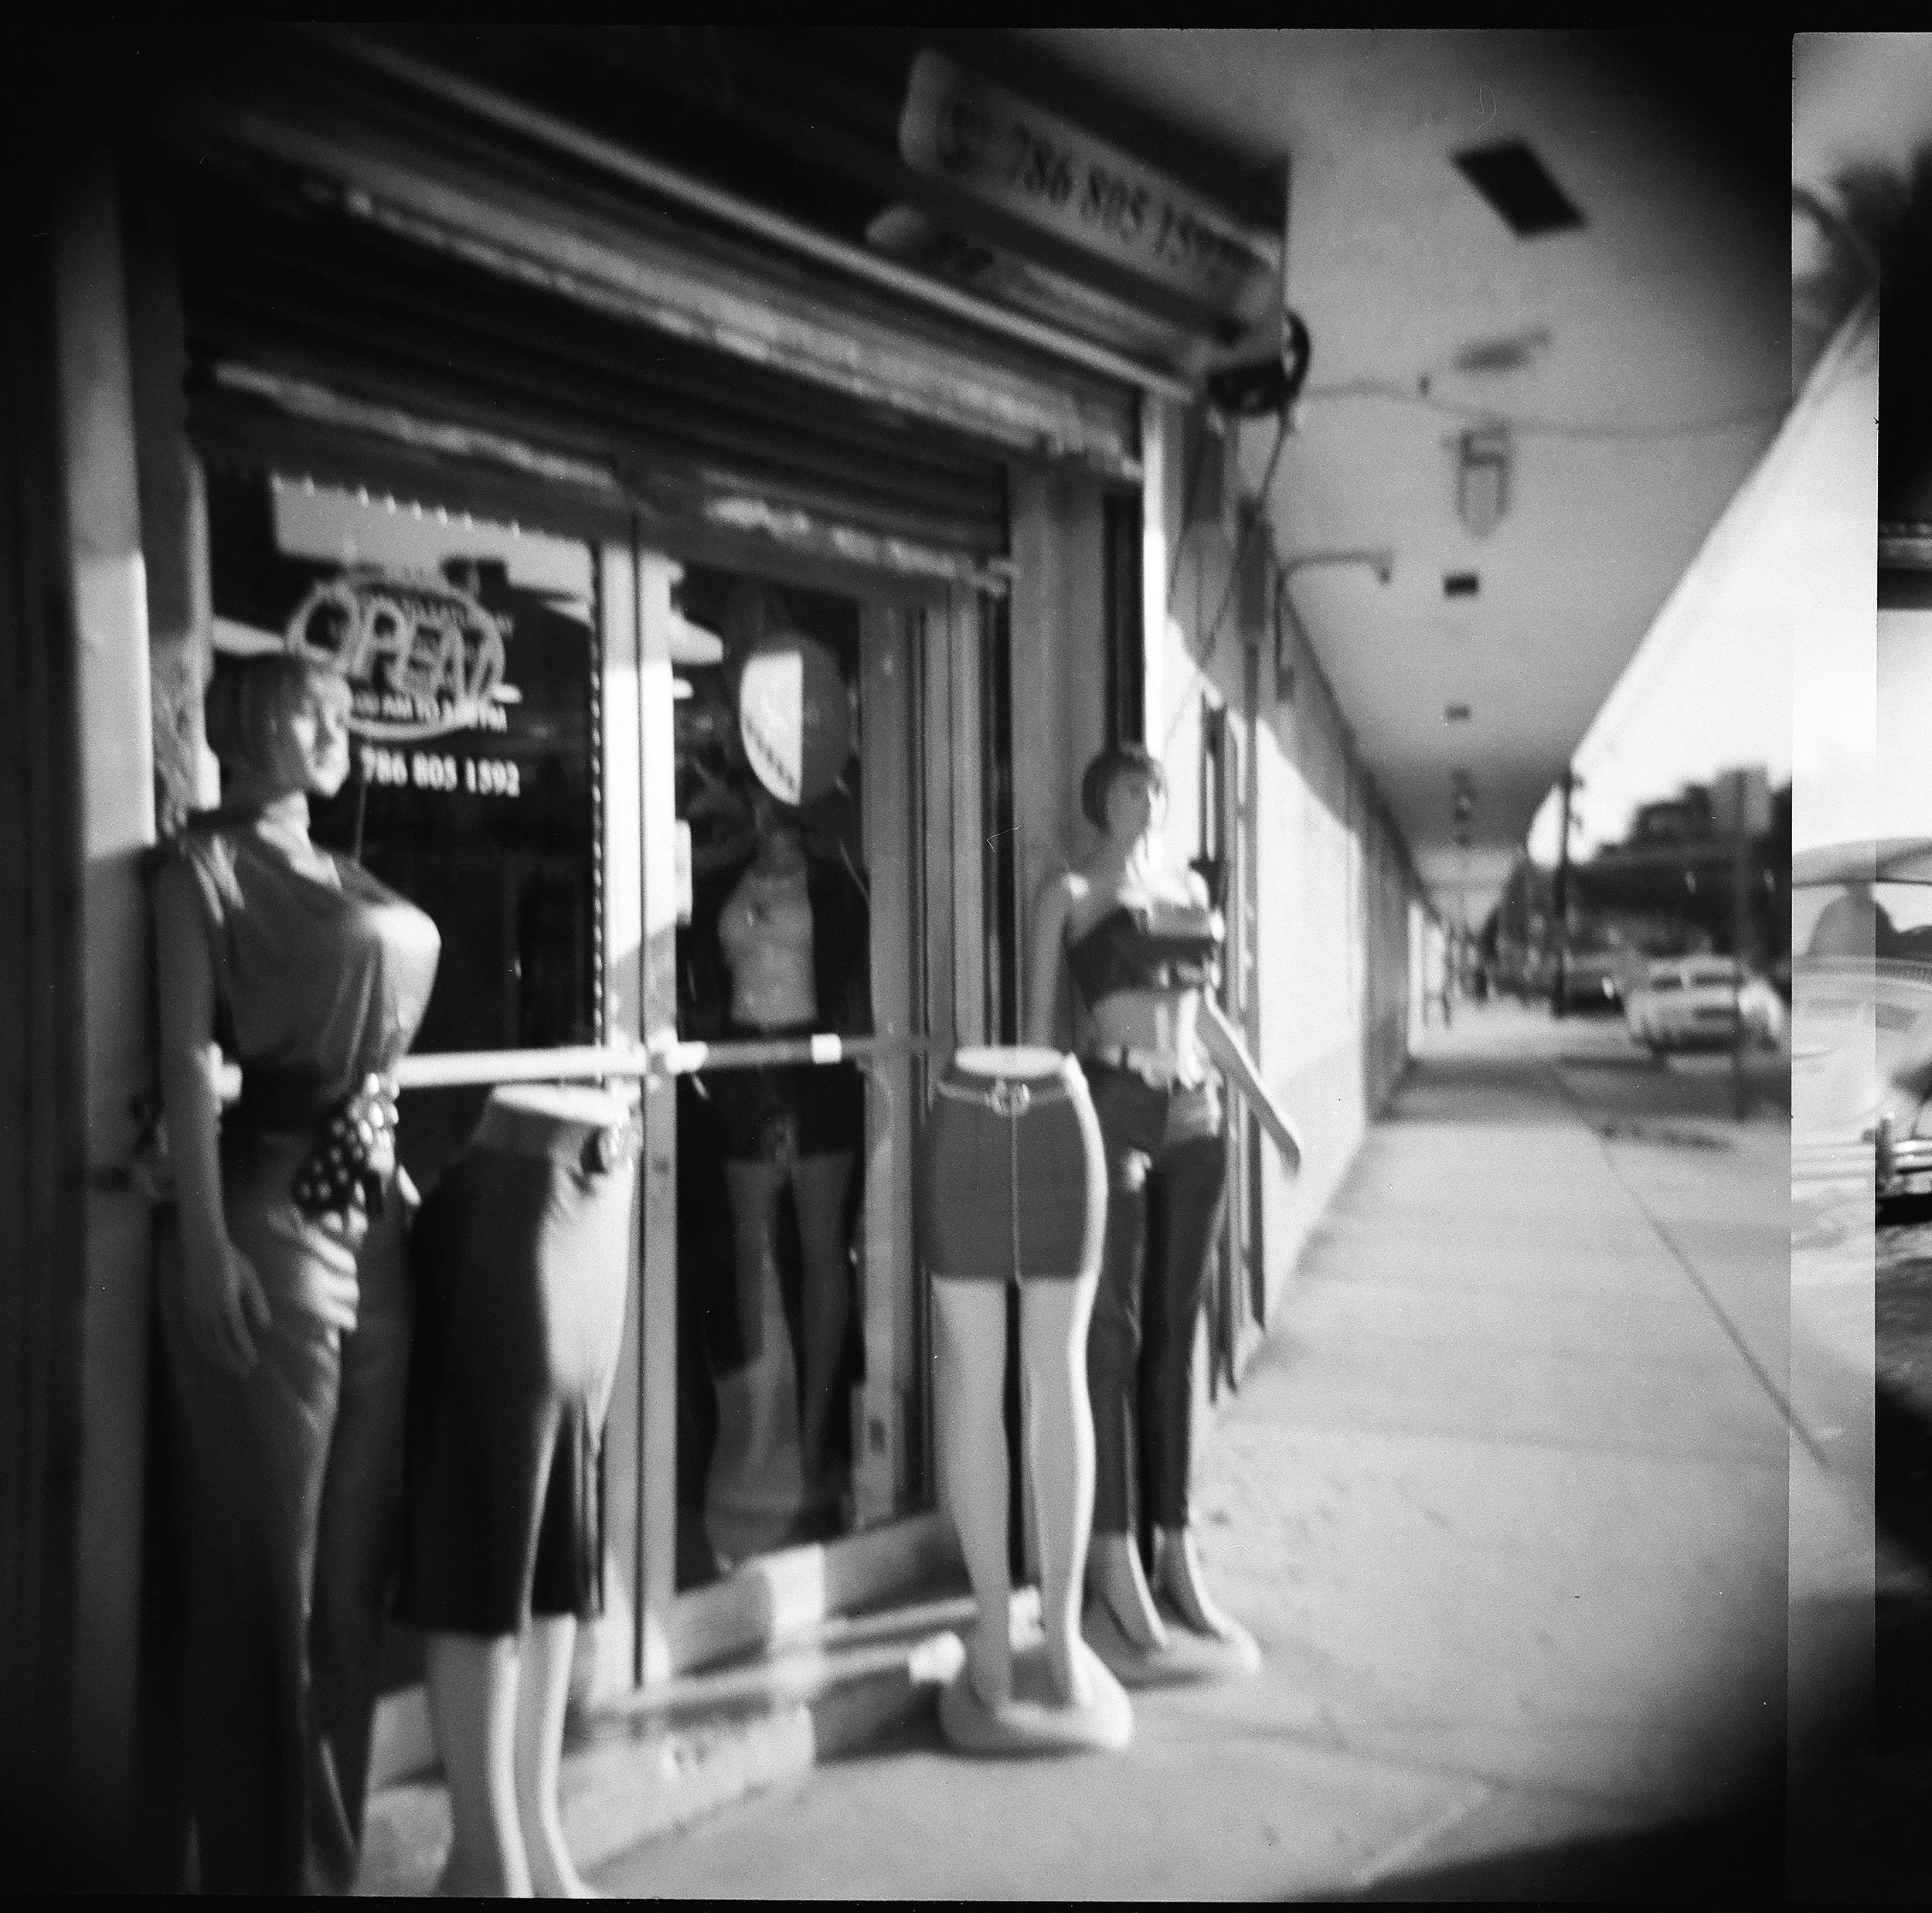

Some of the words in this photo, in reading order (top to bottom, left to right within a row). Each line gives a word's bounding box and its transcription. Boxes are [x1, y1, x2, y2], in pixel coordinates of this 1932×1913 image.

[1006, 122, 1073, 204] 786
[284, 581, 505, 701] OPEN
[359, 744, 409, 787] 786
[412, 748, 458, 792] 805
[465, 755, 521, 798] 1592
